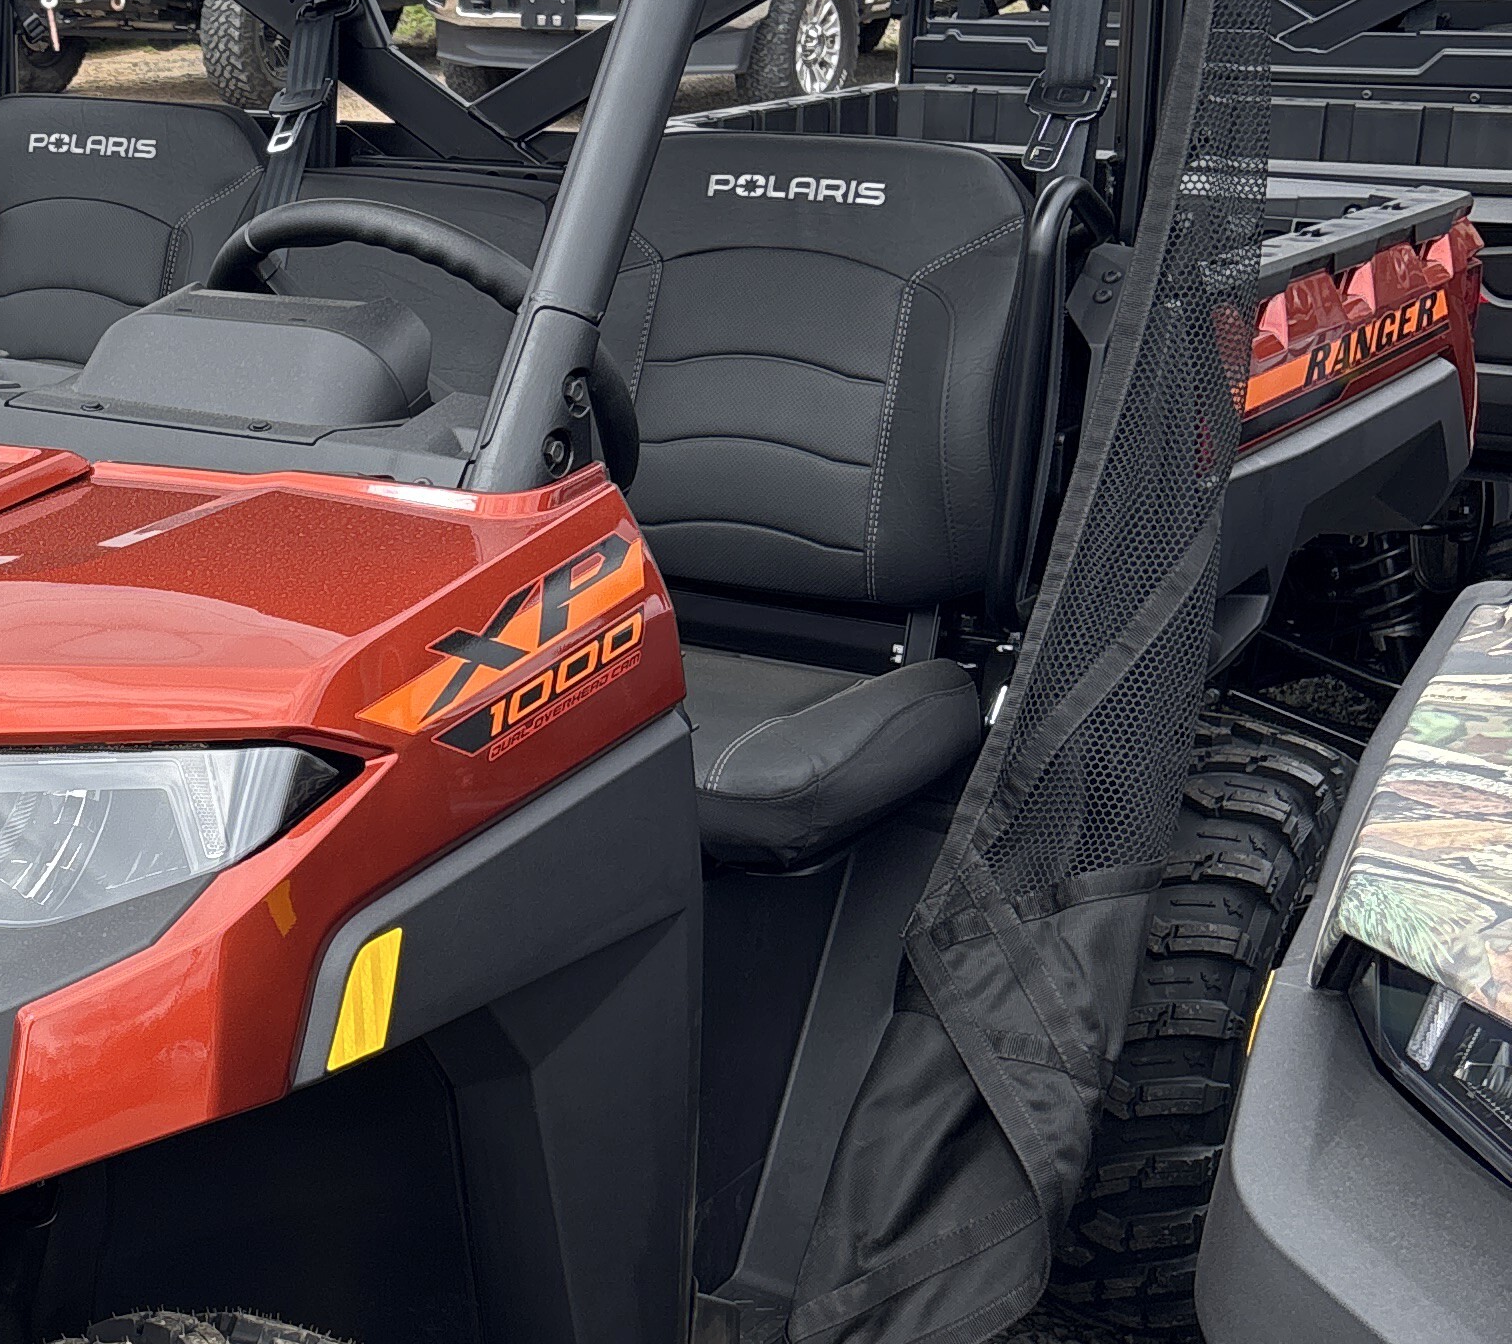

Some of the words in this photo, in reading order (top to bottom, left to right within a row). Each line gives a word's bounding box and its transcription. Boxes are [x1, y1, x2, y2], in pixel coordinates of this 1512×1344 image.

[28, 133, 157, 158] POLARIS
[707, 174, 886, 206] POLARIS
[1303, 290, 1438, 388] RANGER
[418, 532, 632, 724] XP
[490, 612, 642, 736] 1000
[491, 727, 531, 757] DUAL
[533, 674, 609, 729] OVERHEAD
[610, 654, 641, 678] CAM
